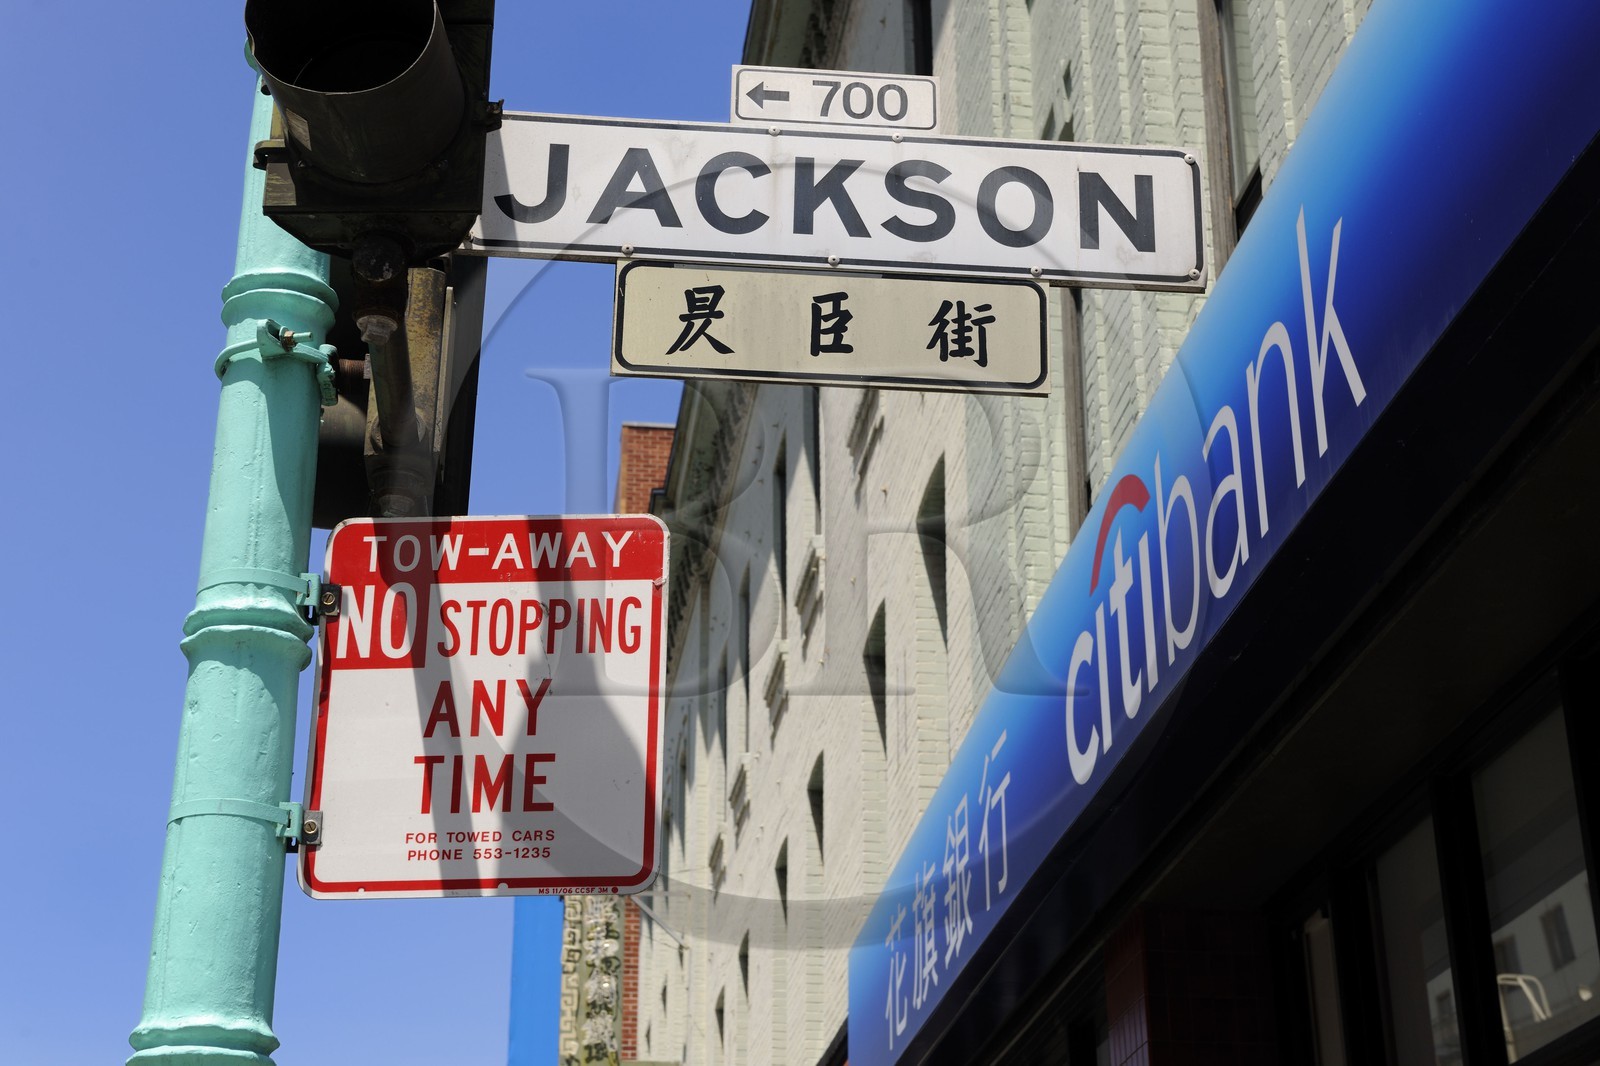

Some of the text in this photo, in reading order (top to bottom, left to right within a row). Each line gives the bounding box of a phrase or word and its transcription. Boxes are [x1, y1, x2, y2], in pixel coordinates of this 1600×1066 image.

[812, 80, 909, 122] 700
[493, 143, 1157, 253] JACKSON
[1064, 204, 1368, 786] citibank
[363, 530, 634, 573] TOW-AWAY
[335, 581, 642, 659] NO STOPPING
[423, 678, 553, 739] ANY
[413, 753, 556, 815] TIME
[405, 830, 555, 844] FOR TOWED CARS
[407, 847, 551, 861] PHONE 553-1235
[885, 729, 1011, 1051] 花旗銀行
